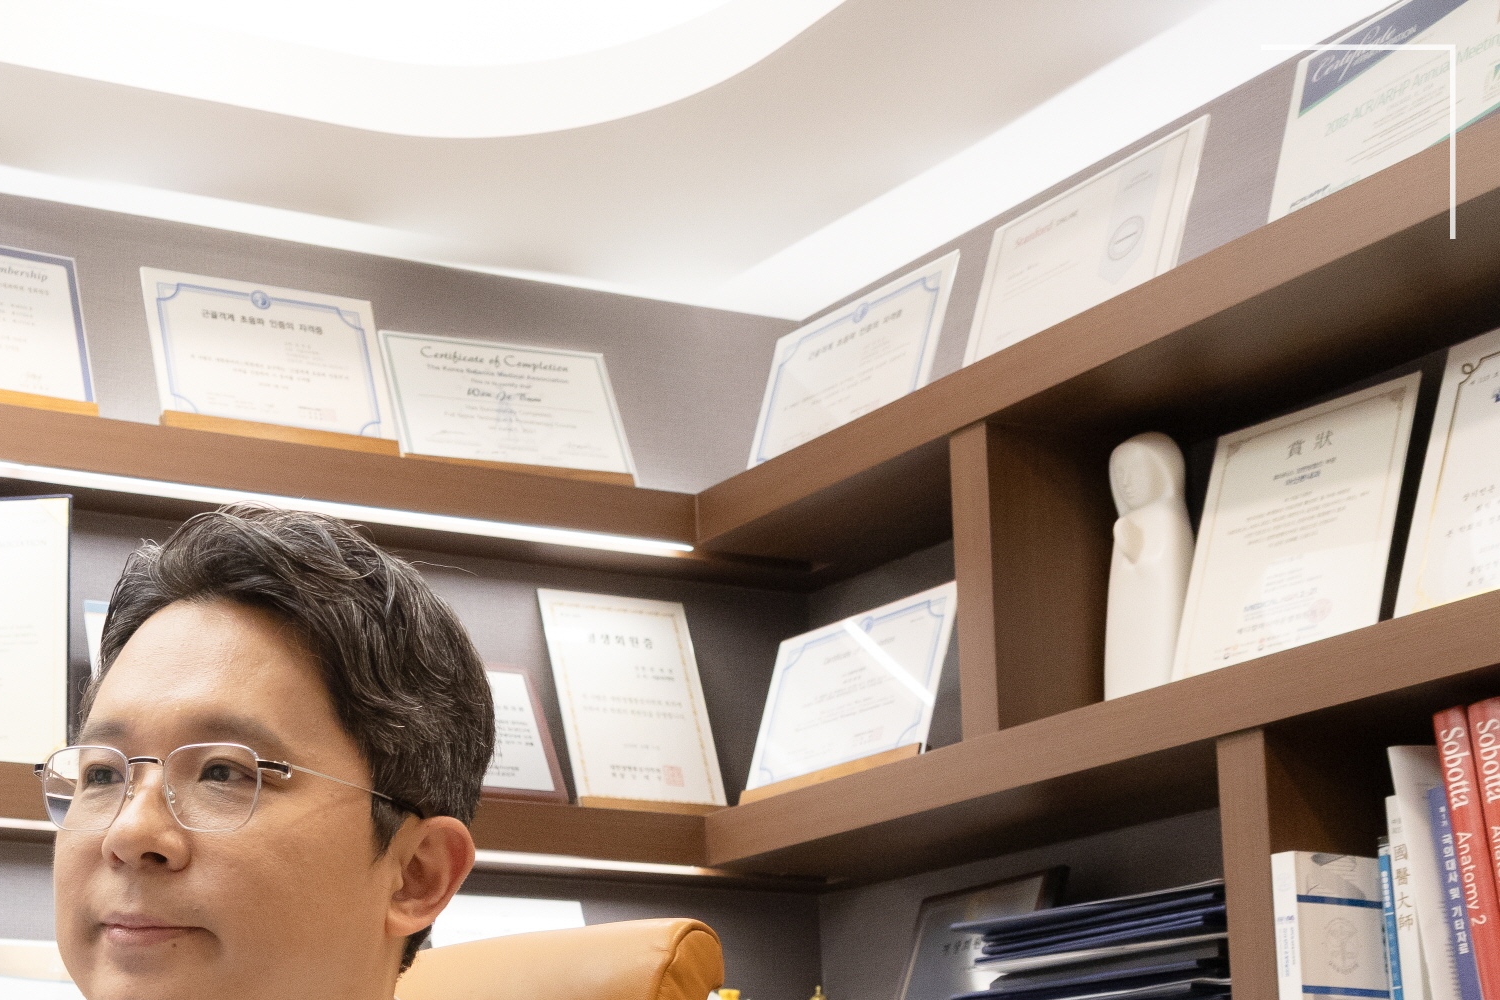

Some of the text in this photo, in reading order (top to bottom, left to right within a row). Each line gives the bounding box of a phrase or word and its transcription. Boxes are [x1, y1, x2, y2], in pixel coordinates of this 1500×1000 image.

[1412, 60, 1451, 87] Annua
[1456, 34, 1500, 63] Meetin
[420, 346, 484, 364] Certificate
[489, 353, 501, 368] of
[503, 354, 569, 373] Completion
[1477, 718, 1500, 804] Sobotta
[1440, 726, 1487, 926] Sobotta Anatomy 2
[1394, 844, 1414, 931] 國醫大師
